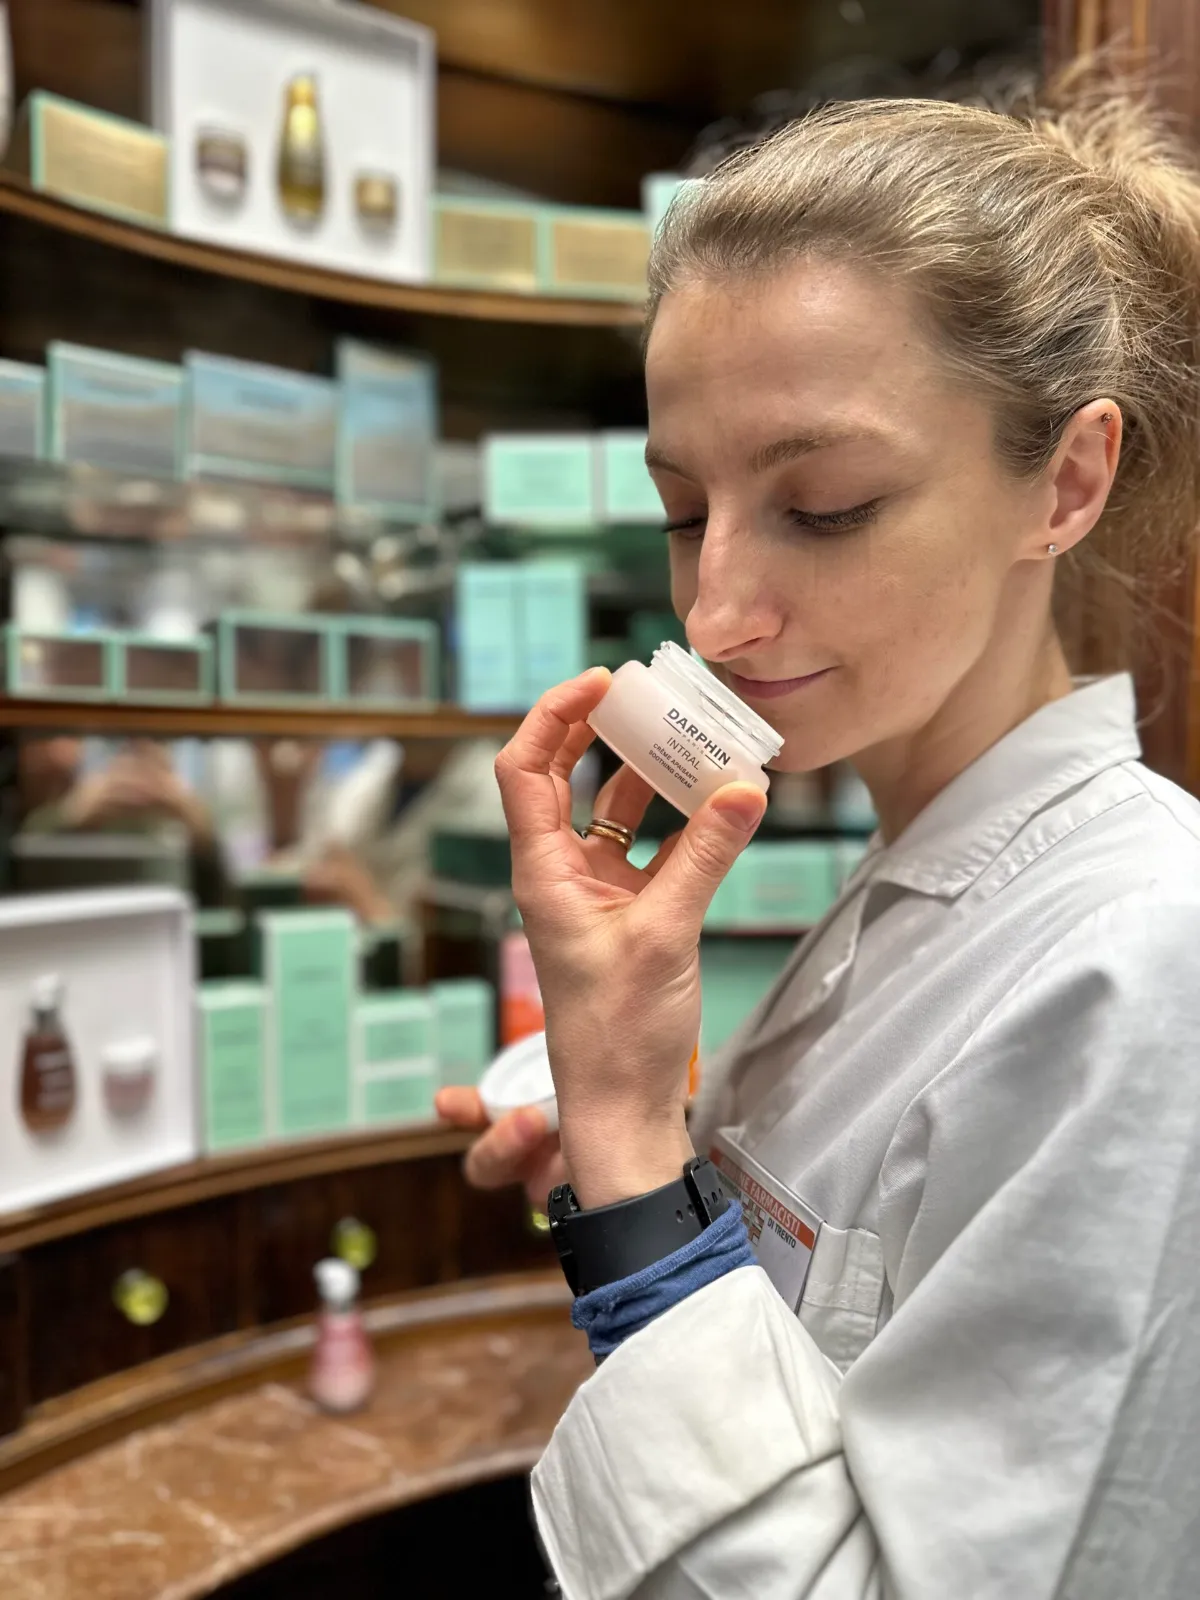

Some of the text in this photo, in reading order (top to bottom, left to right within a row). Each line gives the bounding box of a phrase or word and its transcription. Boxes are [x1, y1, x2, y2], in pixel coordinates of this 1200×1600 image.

[666, 737, 699, 770] INTRAL
[667, 708, 731, 766] DARPHIN
[648, 750, 693, 789] SOOTHING CREAM
[653, 743, 699, 784] CRÈME APAISANTE
[751, 1183, 801, 1236] FARMACISTI
[767, 1216, 797, 1249] DI TRENTO
